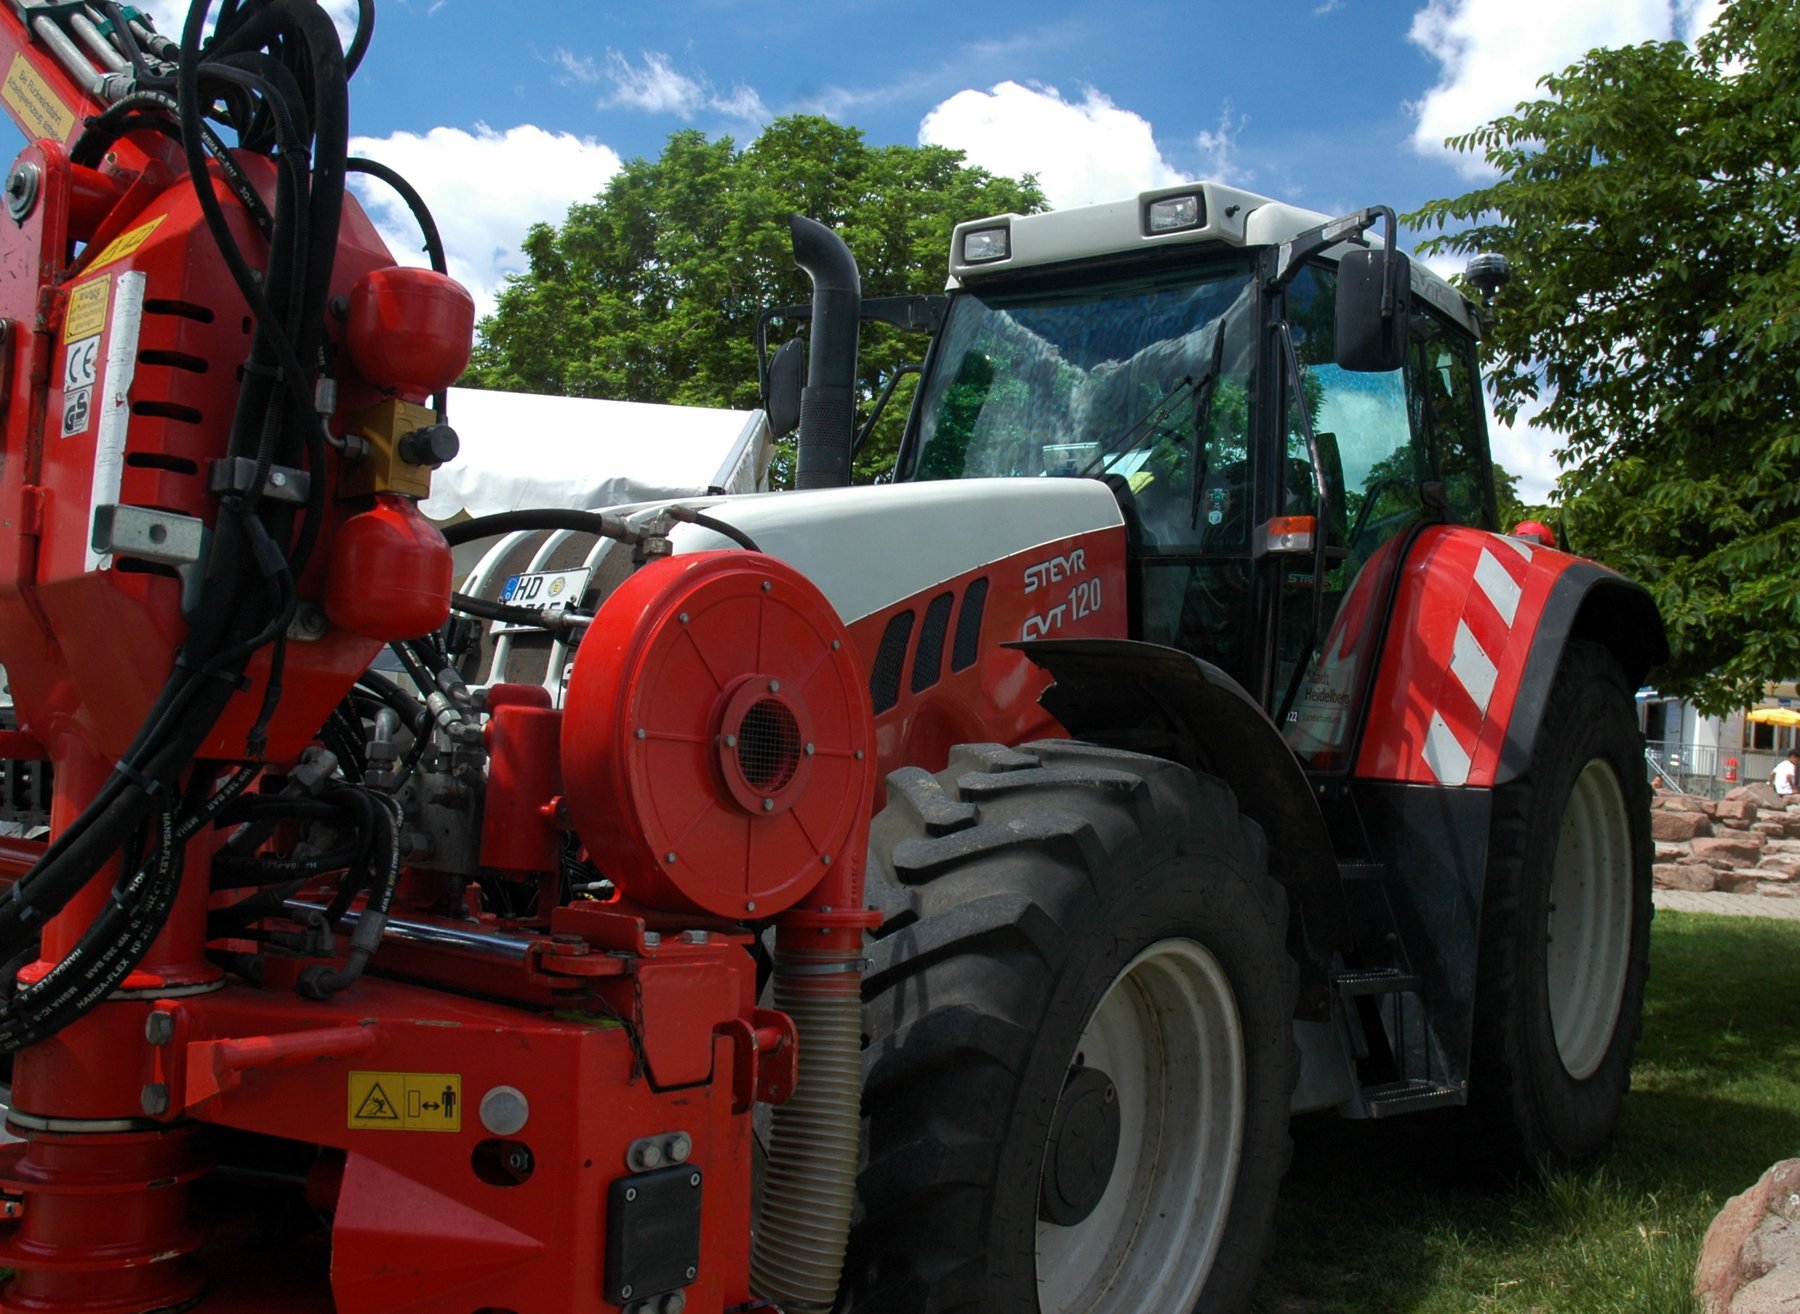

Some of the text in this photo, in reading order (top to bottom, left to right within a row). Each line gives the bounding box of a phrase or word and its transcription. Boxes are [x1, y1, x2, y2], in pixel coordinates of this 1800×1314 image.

[69, 342, 95, 384] CE
[513, 576, 544, 601] HD
[1024, 547, 1087, 595] STEYR
[1022, 576, 1102, 641] CVT 120
[1304, 688, 1350, 709] Heidelberg
[76, 958, 130, 1010] HANSA-FLEX
